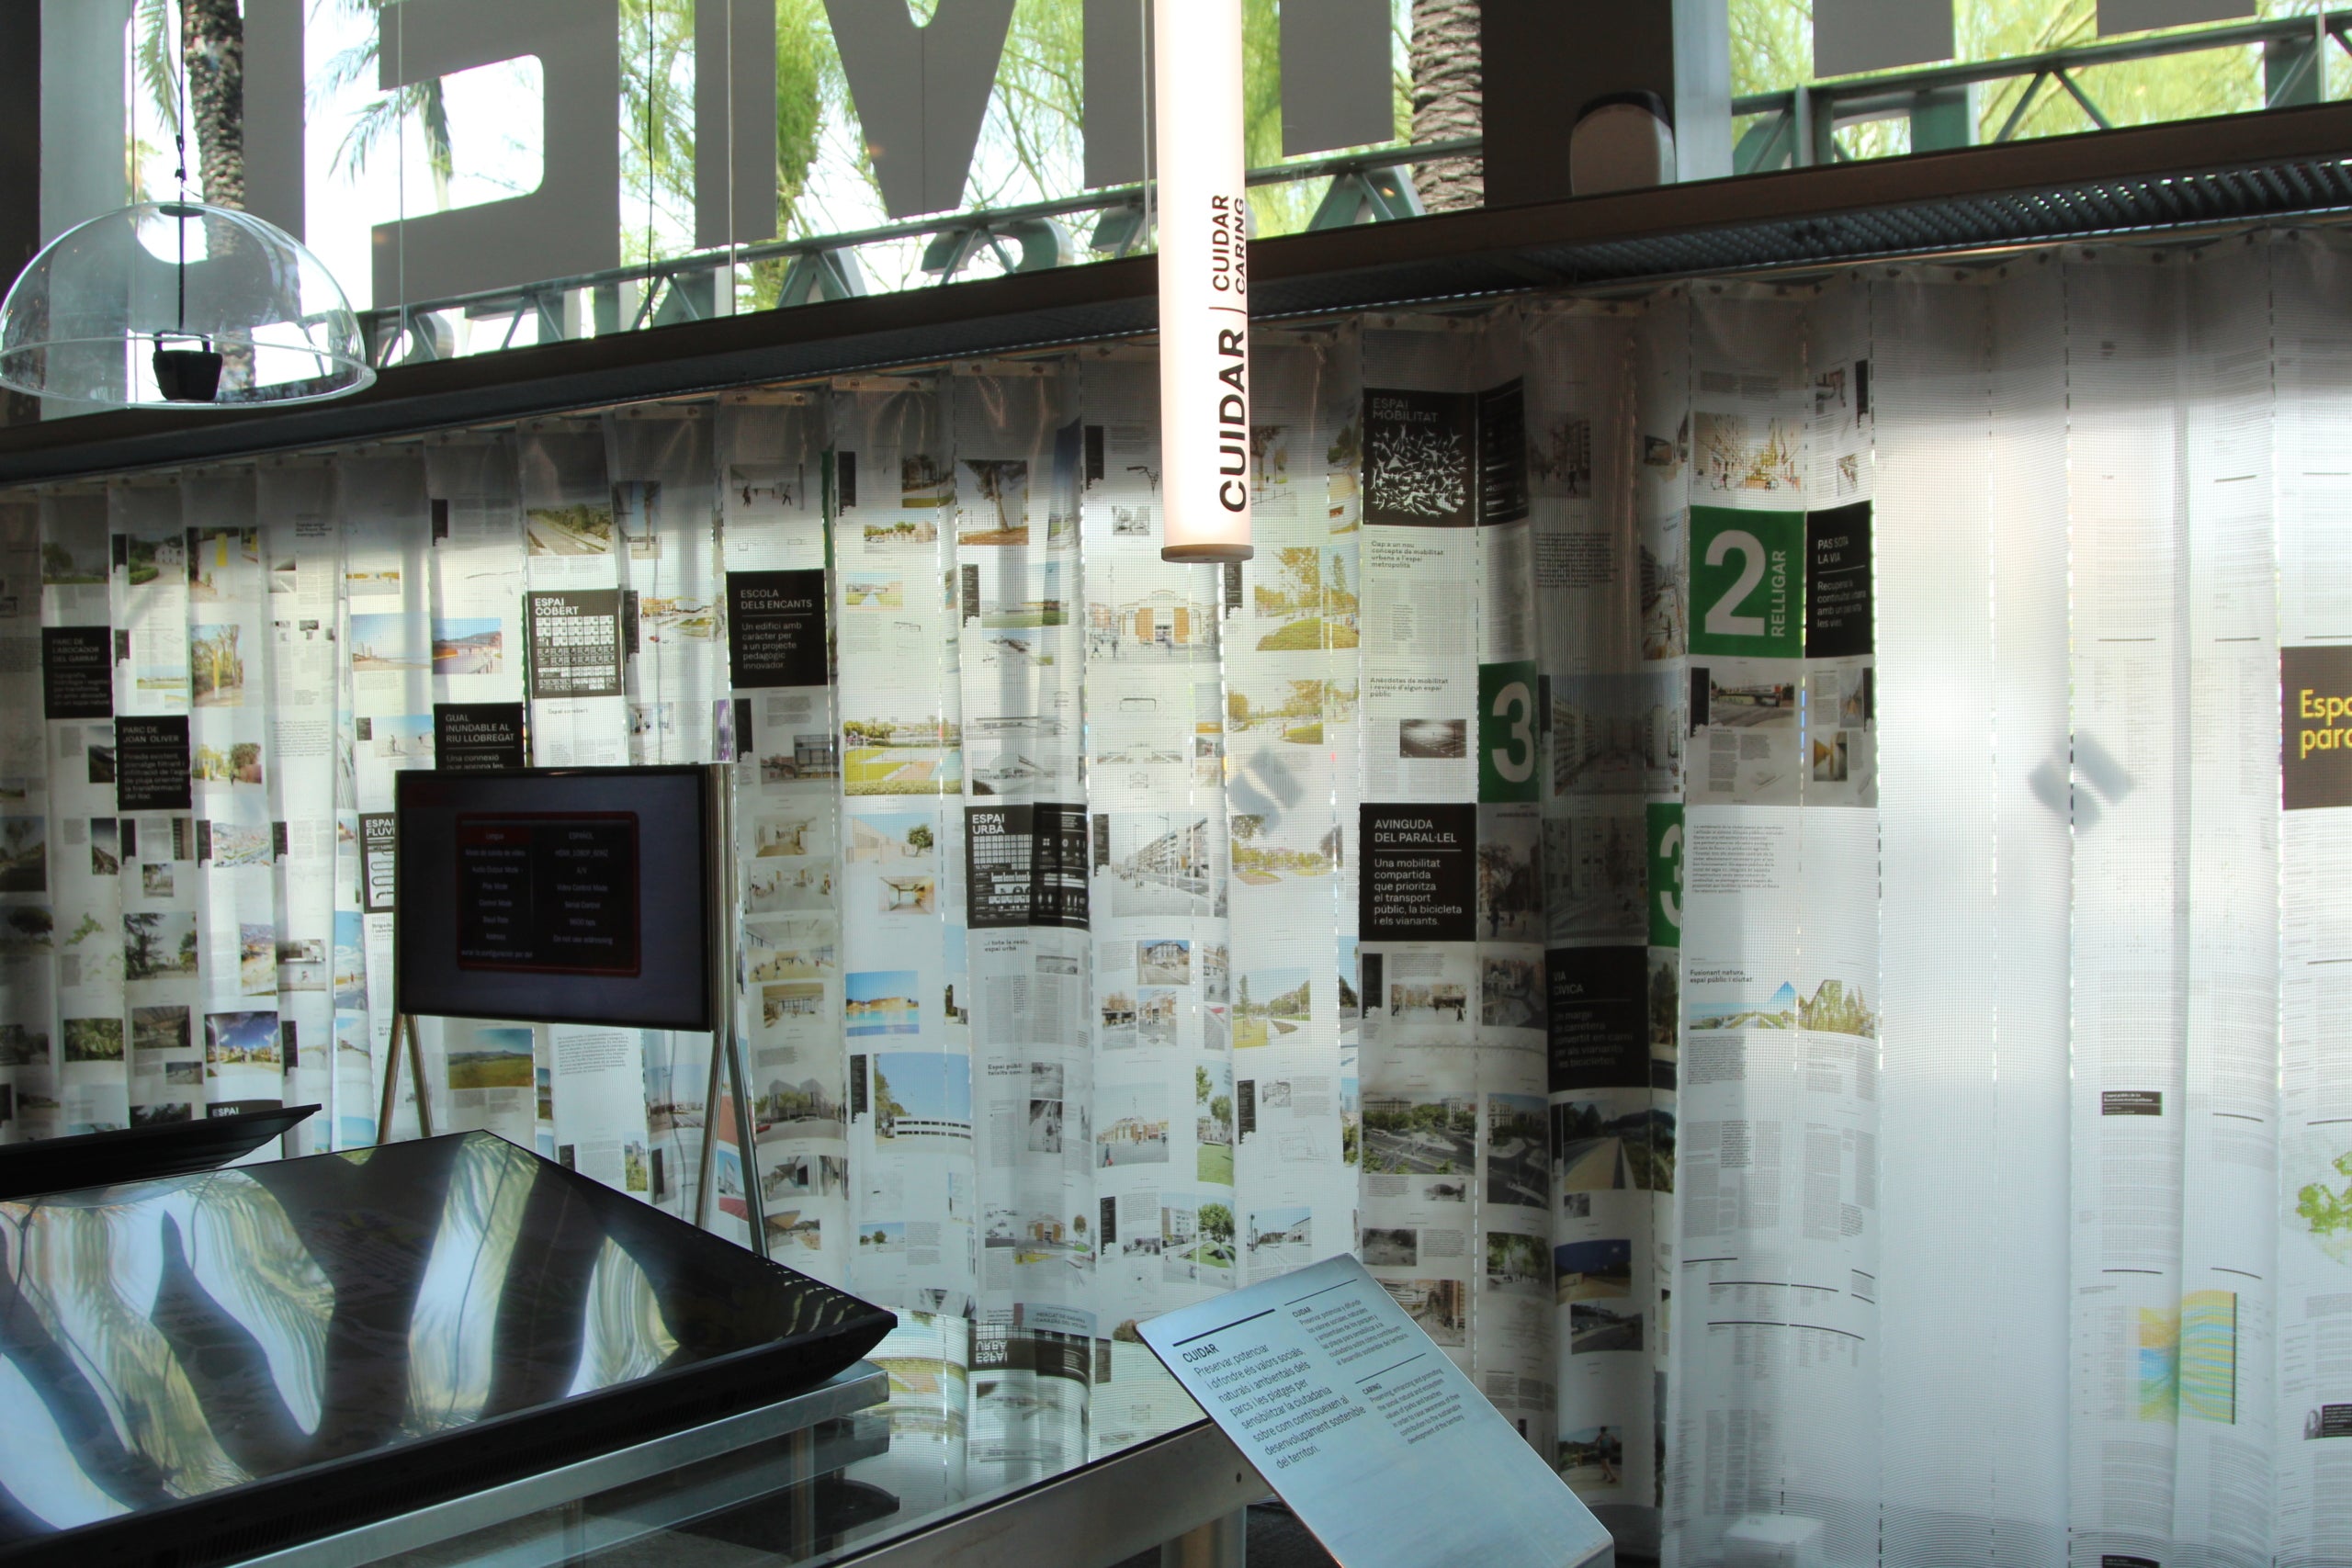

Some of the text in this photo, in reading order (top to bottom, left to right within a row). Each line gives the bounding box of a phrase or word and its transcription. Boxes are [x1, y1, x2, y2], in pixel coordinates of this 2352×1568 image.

[1213, 195, 1229, 291] CUIDAR
[1235, 198, 1246, 296] CARING
[1373, 398, 1408, 409] ESPAI
[1218, 329, 1247, 513] CUIDAR
[1373, 410, 1439, 422] MOBILITAT
[1817, 538, 1833, 550] PAS
[1817, 552, 1841, 565] LA VIA
[1705, 529, 1766, 636] 2
[1771, 550, 1786, 637] RELLIGAR
[741, 589, 779, 599] ESCOLA
[535, 598, 564, 607] ESPAI
[741, 599, 812, 610] DELS ENCANTS
[535, 606, 579, 616] COBERT
[741, 621, 802, 631] Un edifici amb
[742, 632, 792, 642] caràcter per
[763, 641, 797, 652] projecte
[446, 714, 469, 723] GUAL
[122, 726, 158, 734] PARC DE
[446, 723, 510, 733] INUNDABLE AL
[1492, 682, 1534, 783] 3
[122, 734, 179, 744] JOAN OLIVER
[446, 733, 514, 743] RIU LLOBREGAT
[447, 753, 500, 762] Una connexió
[366, 818, 395, 828] ESPAI
[972, 813, 1005, 824] ESPAI
[1374, 818, 1433, 829] AVINGUDA
[366, 827, 395, 837] FLUVI
[972, 821, 1005, 835] URBÀ
[1374, 832, 1457, 843] DEL PARAL·LEL
[1374, 858, 1441, 868] Una mobilitat
[1374, 870, 1431, 881] compartida
[1374, 882, 1437, 893] que prioritza
[1374, 893, 1431, 904] el transport
[1374, 905, 1463, 917] públic, la bicicleta
[1379, 916, 1394, 926] els
[1690, 976, 1706, 985] espai
[212, 1106, 240, 1117] ESPAI
[1182, 1343, 1220, 1364] CUIDAR
[1193, 1344, 1270, 1378] Preservar, potenciar
[1210, 1369, 1244, 1390] difondre
[1244, 1364, 1257, 1377] els
[1255, 1356, 1280, 1372] valors
[1218, 1383, 1251, 1404] naturals
[1252, 1368, 1295, 1390] ambientals
[1293, 1359, 1311, 1374] dels
[1229, 1401, 1255, 1419] parcs
[1255, 1393, 1269, 1406] les
[1267, 1382, 1297, 1403] platges
[1295, 1379, 1309, 1393] per
[1241, 1385, 1333, 1430] sensibilitzar la ciutadania
[1252, 1394, 1351, 1443] sobre com contribueixen al
[1264, 1404, 1367, 1456] desenvolupament sostenible
[1276, 1443, 1321, 1471] del territori.
